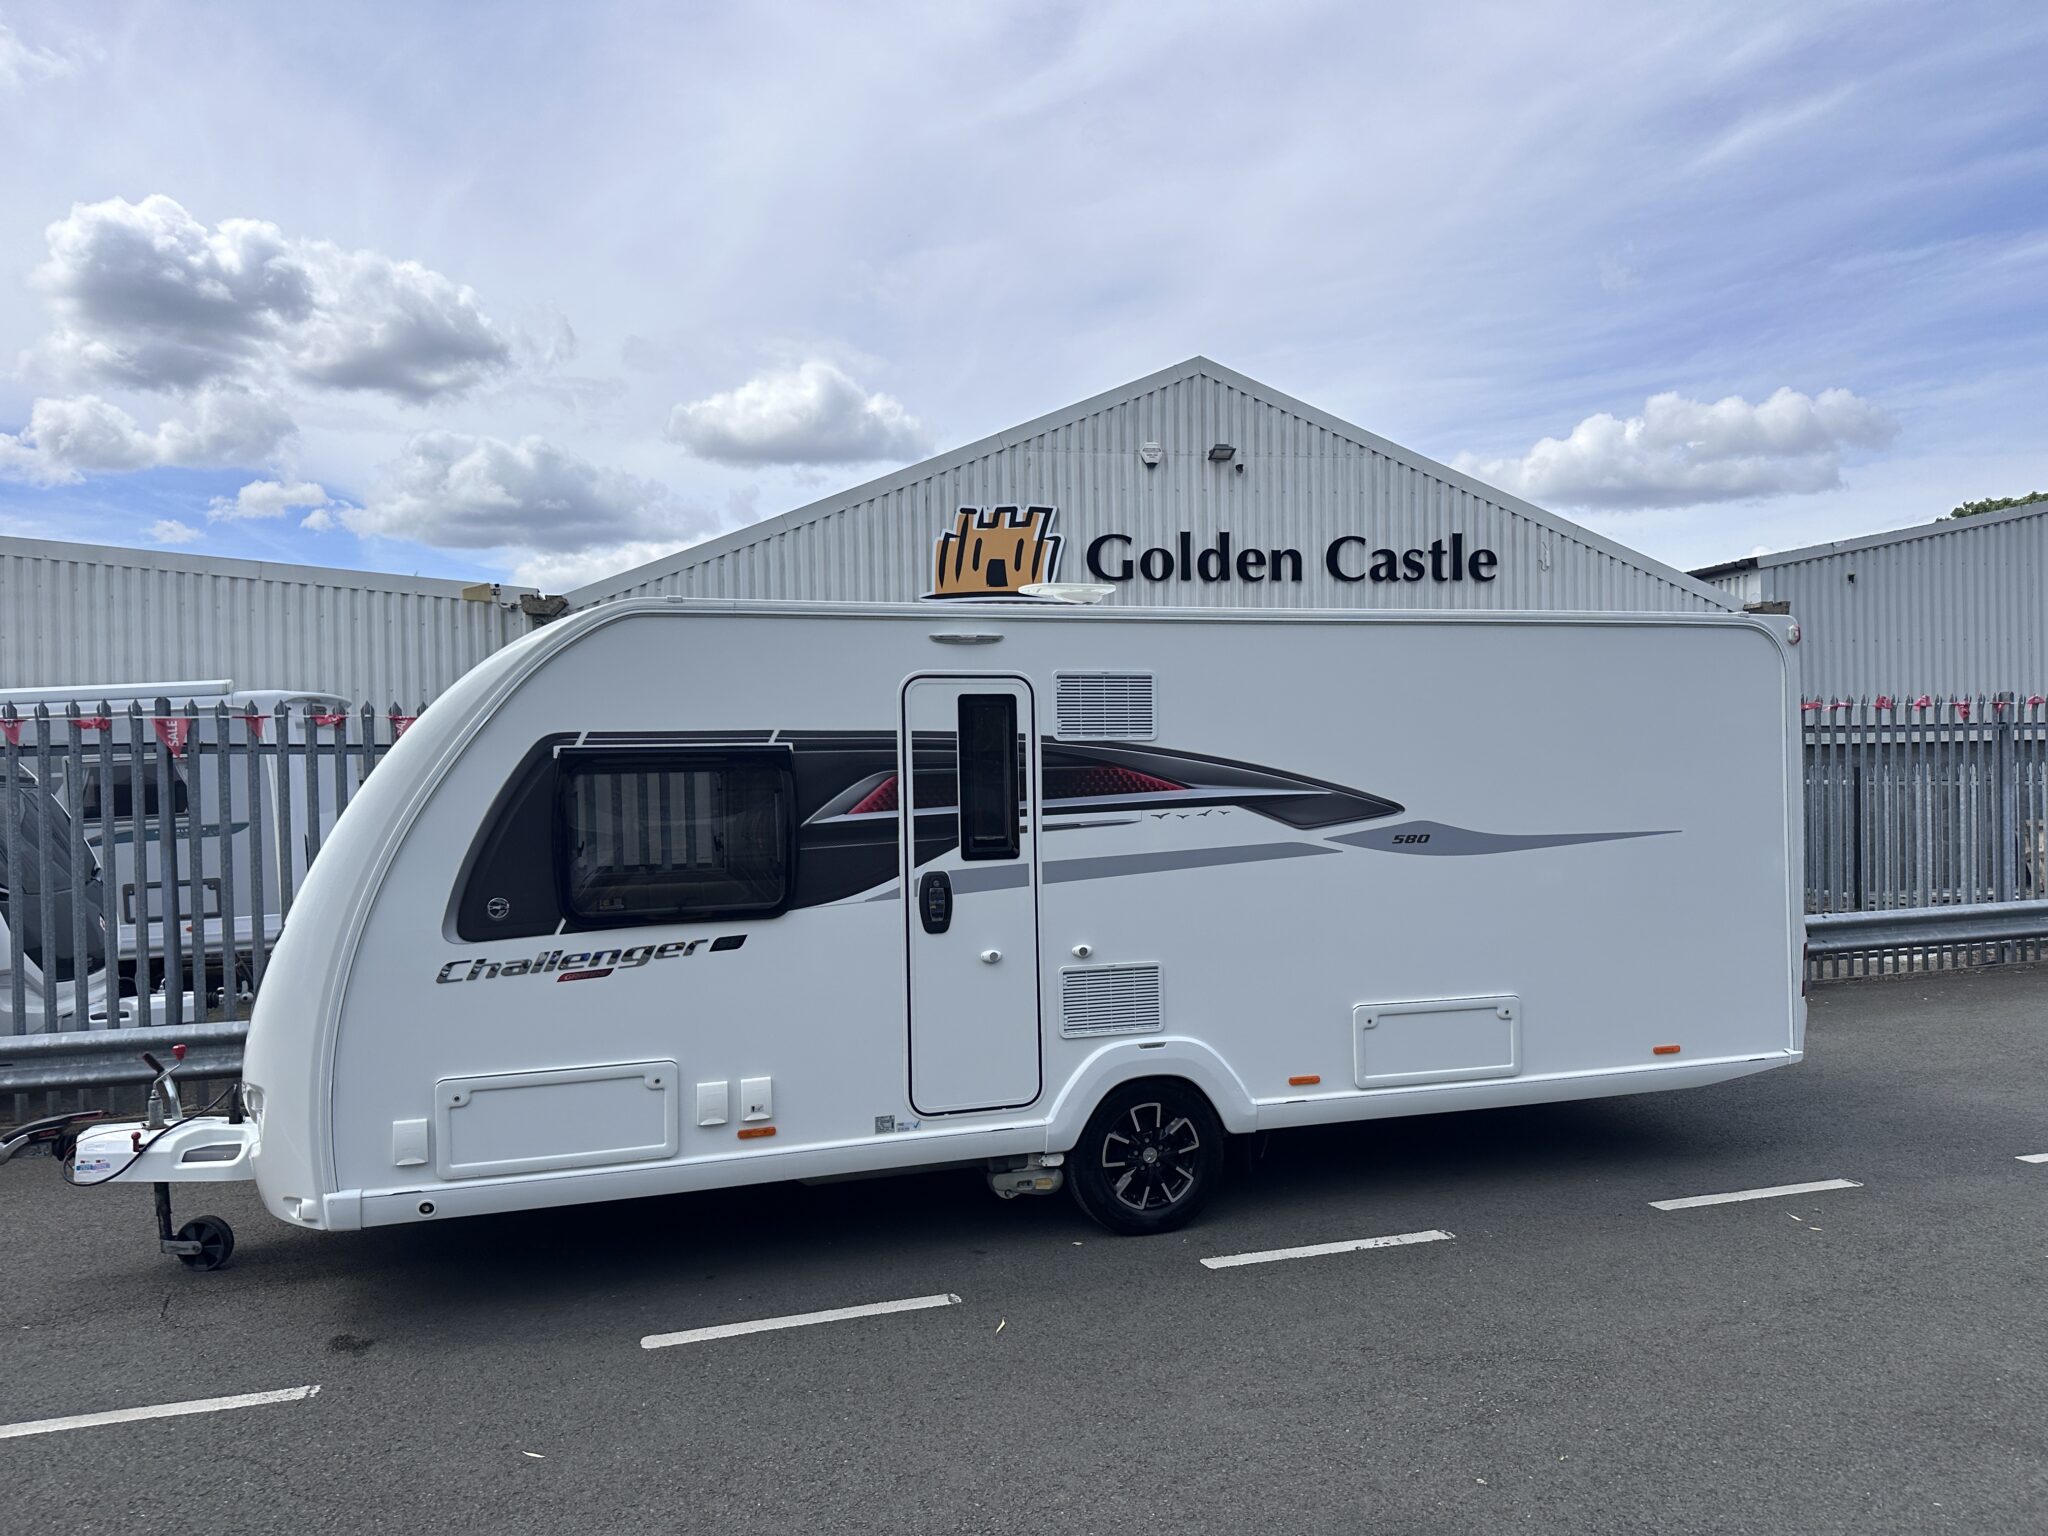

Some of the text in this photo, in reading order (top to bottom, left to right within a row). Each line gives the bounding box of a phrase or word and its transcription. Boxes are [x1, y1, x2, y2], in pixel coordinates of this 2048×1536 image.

[1086, 531, 1498, 582] Golden Castle
[166, 720, 179, 747] SALE
[1391, 834, 1431, 844] 580
[436, 939, 709, 984] Challenger
